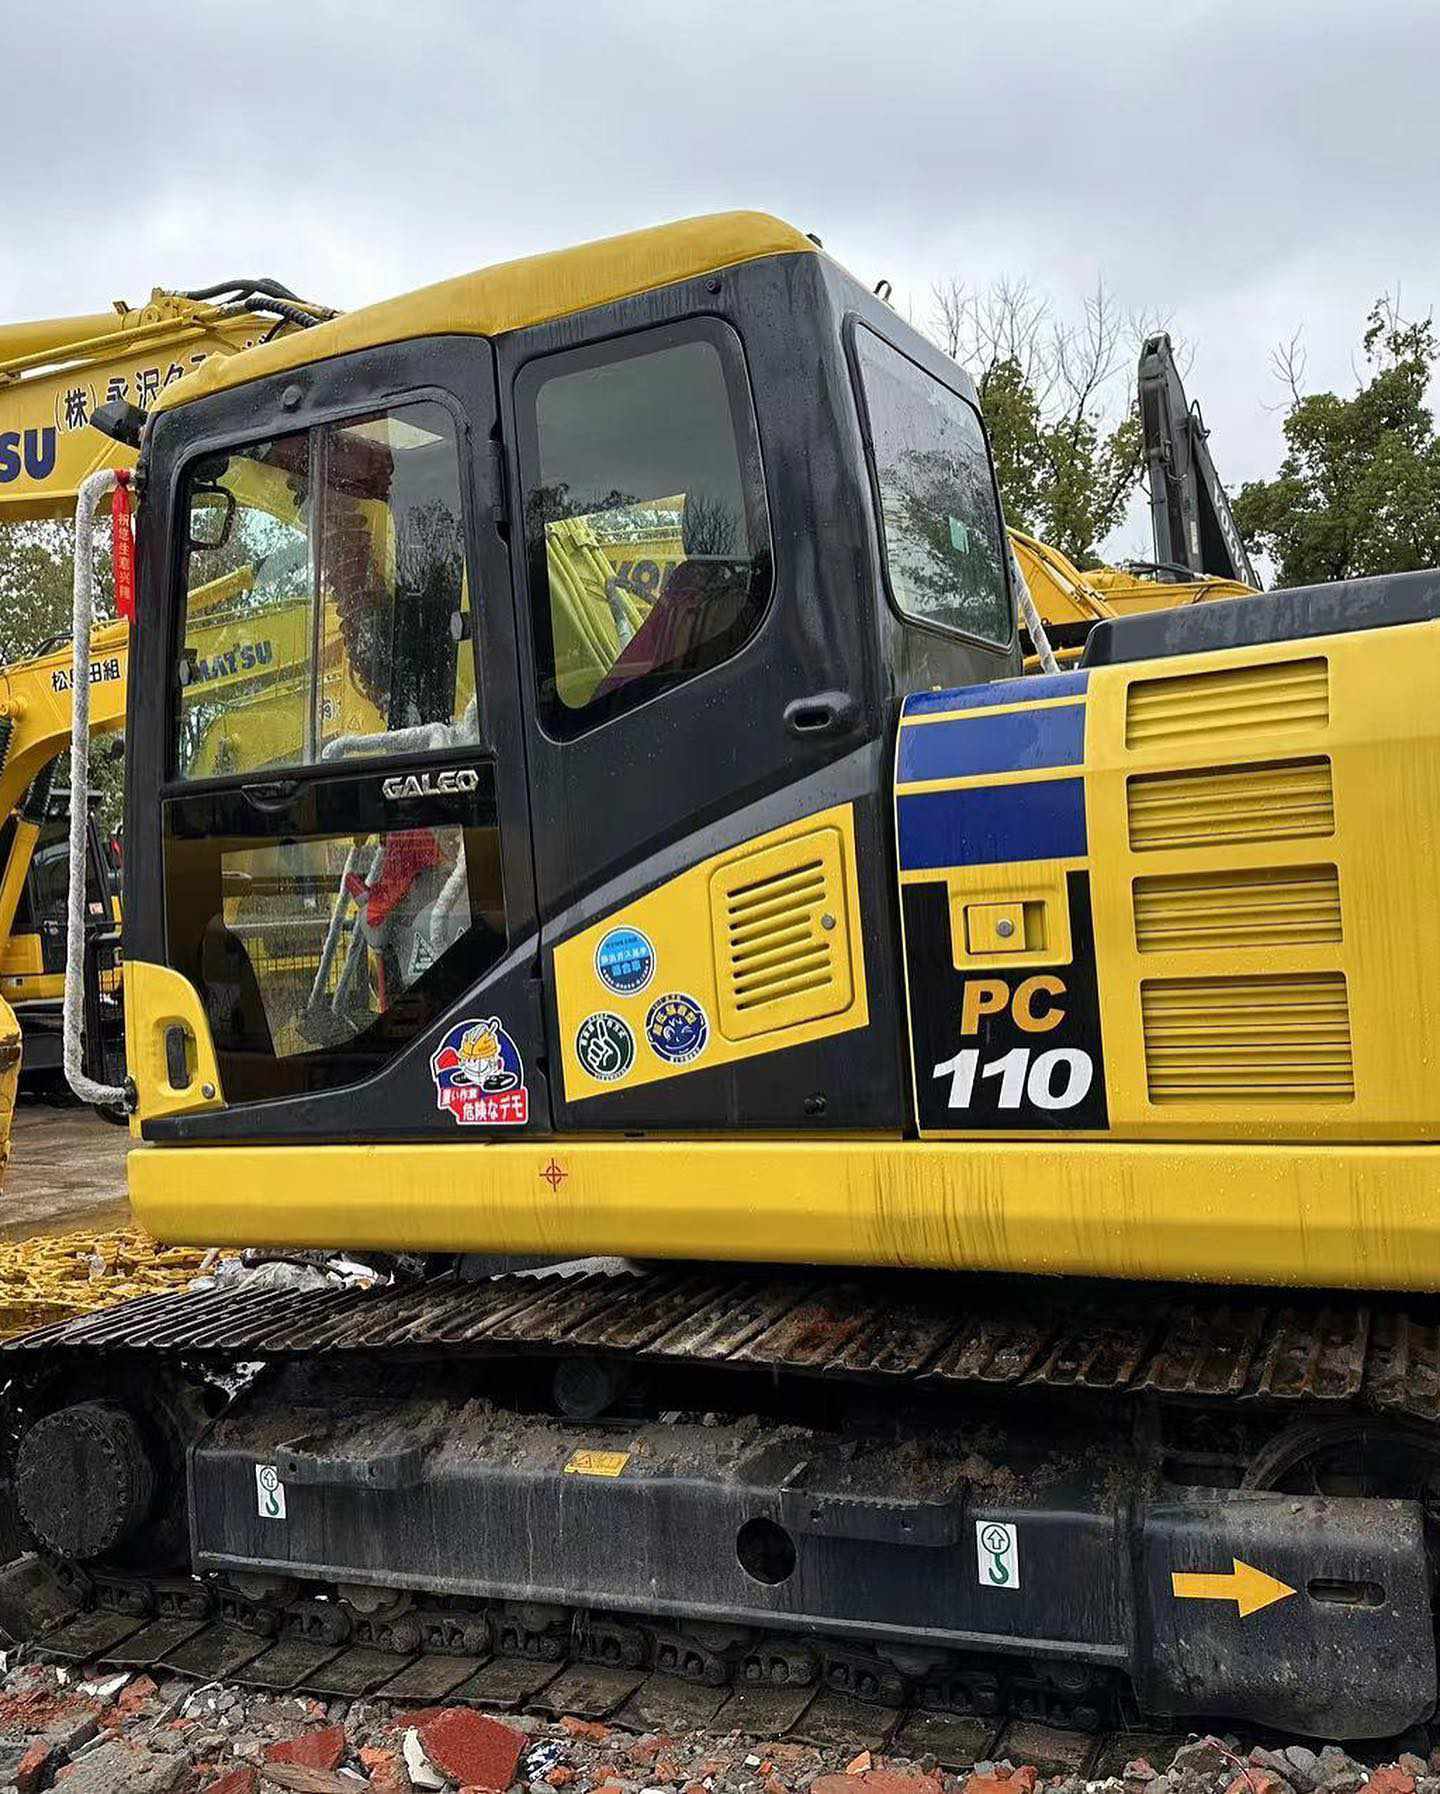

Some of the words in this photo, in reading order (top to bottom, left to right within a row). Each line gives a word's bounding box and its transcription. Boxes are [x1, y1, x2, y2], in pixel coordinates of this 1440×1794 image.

[51, 658, 121, 693] 松田組
[382, 769, 479, 799] GALEO
[960, 974, 1067, 1036] PC
[932, 1047, 1093, 1110] 110
